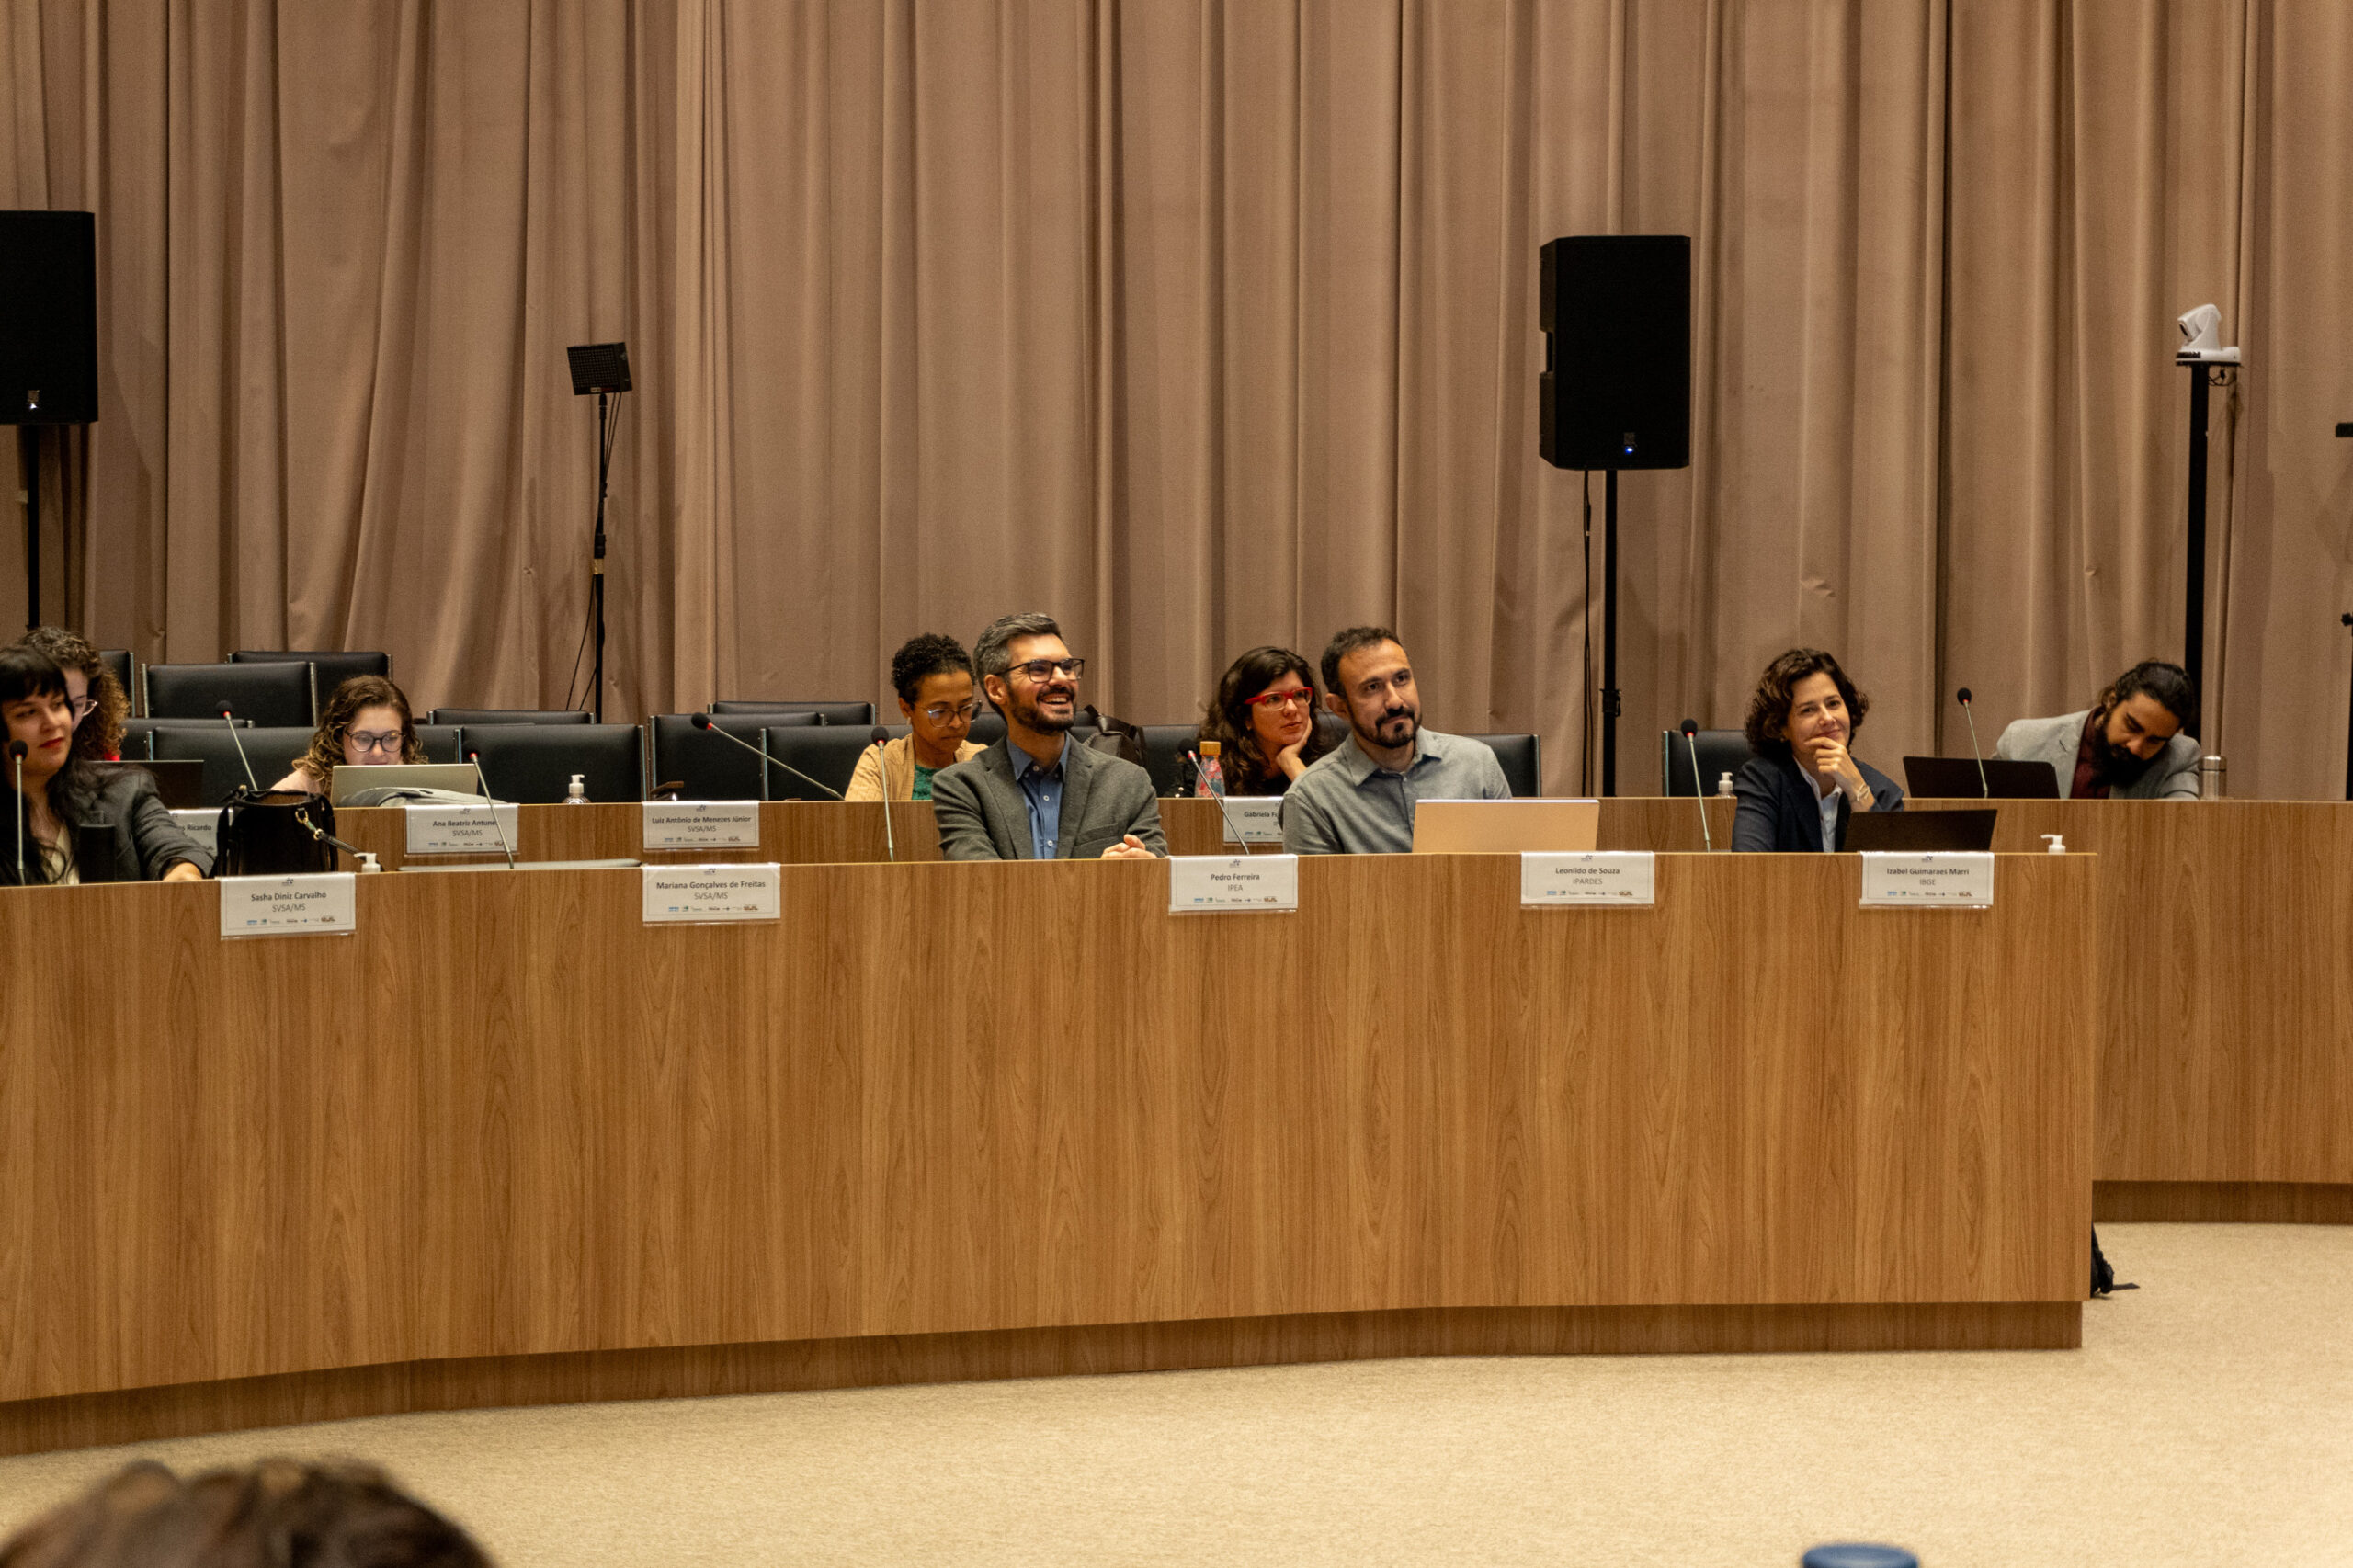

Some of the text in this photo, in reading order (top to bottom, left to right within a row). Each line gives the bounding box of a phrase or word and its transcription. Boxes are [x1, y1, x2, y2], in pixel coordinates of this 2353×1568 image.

[452, 829, 483, 837] SVSA/MS
[1555, 867, 1586, 875] Leonildo
[1598, 867, 1620, 875] Souza
[1886, 867, 1908, 875] Izabel
[1909, 867, 1948, 875] Guimaraes
[656, 880, 766, 891] Mariana Gonçalves de Freitas
[251, 891, 327, 902] Sasha Diniz Carvalho
[694, 892, 729, 901] SVSA/MS
[272, 903, 306, 913] SVSA/MS
